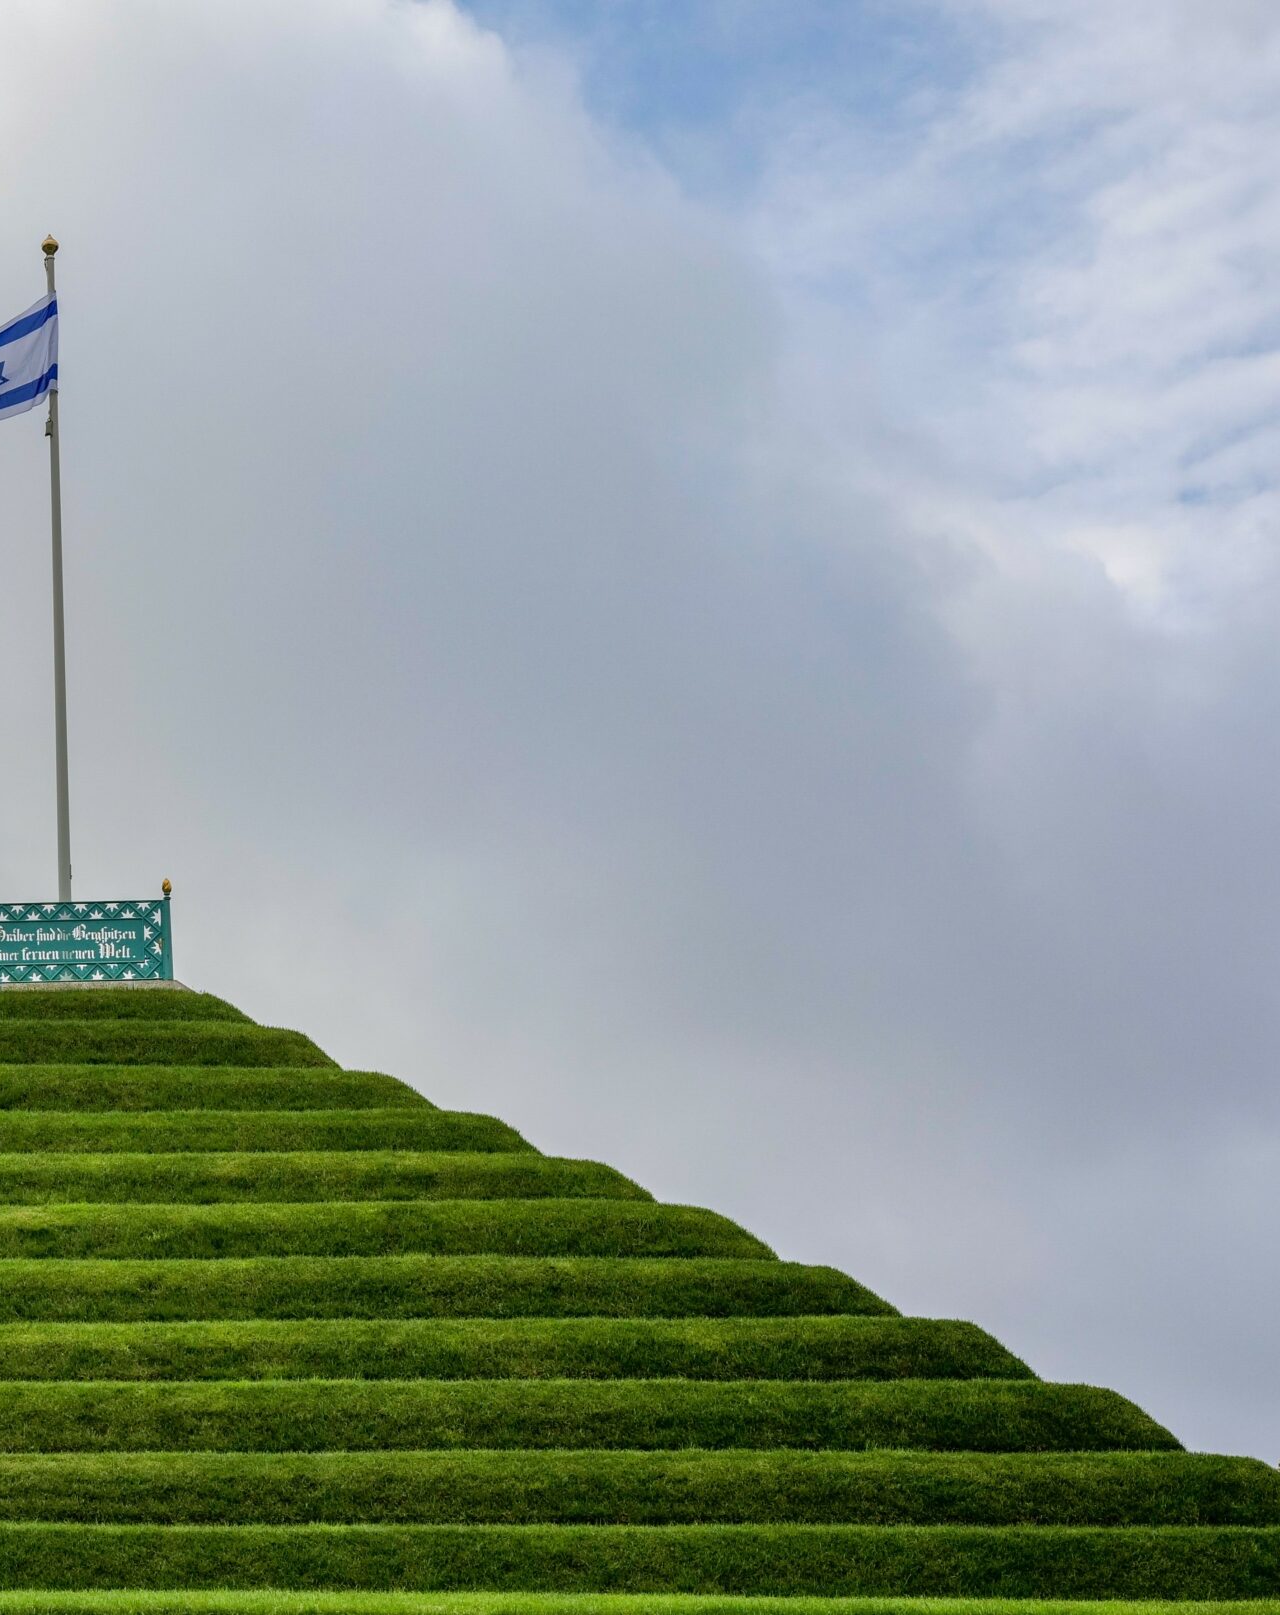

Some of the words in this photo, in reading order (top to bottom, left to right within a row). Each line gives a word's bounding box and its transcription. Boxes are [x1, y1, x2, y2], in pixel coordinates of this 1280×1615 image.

[57, 927, 71, 941] die
[22, 947, 59, 961] fernen
[62, 950, 95, 960] neuen
